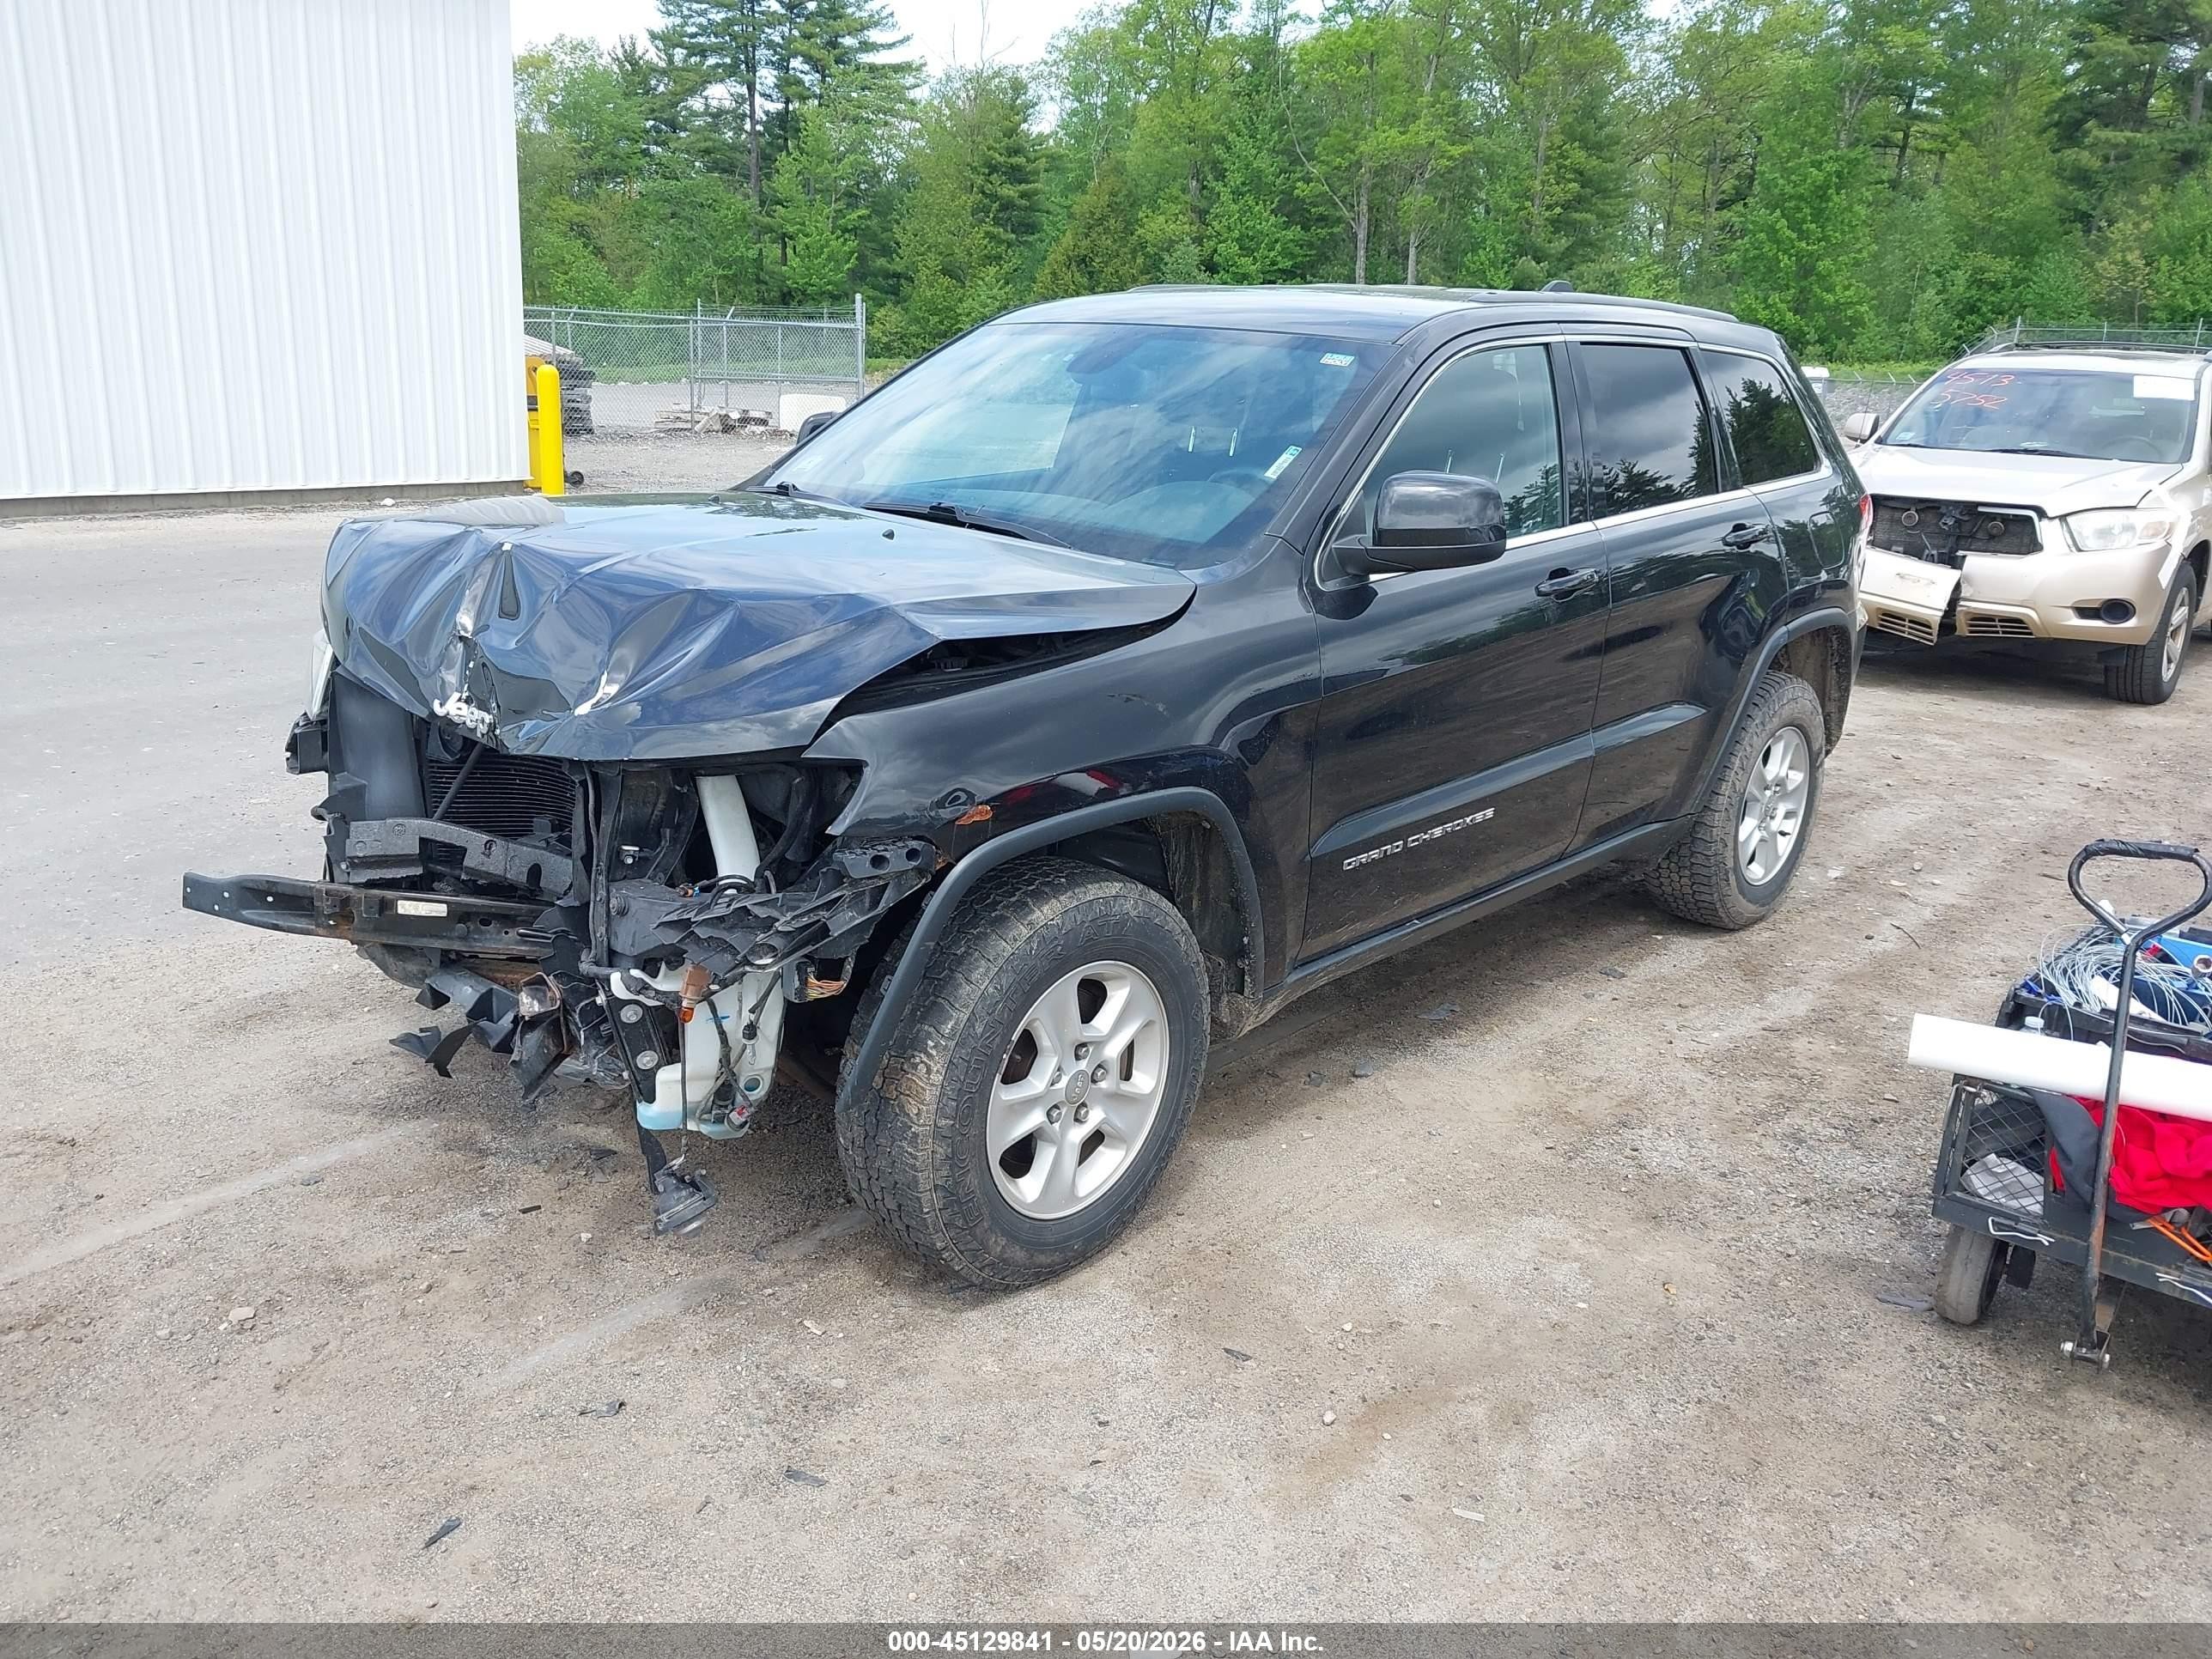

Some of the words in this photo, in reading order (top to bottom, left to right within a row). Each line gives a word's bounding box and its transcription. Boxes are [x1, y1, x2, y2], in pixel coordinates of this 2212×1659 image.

[1930, 389, 2008, 410] 5752
[1944, 371, 2014, 386] 4513
[433, 691, 490, 738] Jeep
[1342, 840, 1404, 871] GRAND
[1407, 806, 1496, 848] CHEROKEE
[953, 945, 1066, 1228] ENCOUNTER
